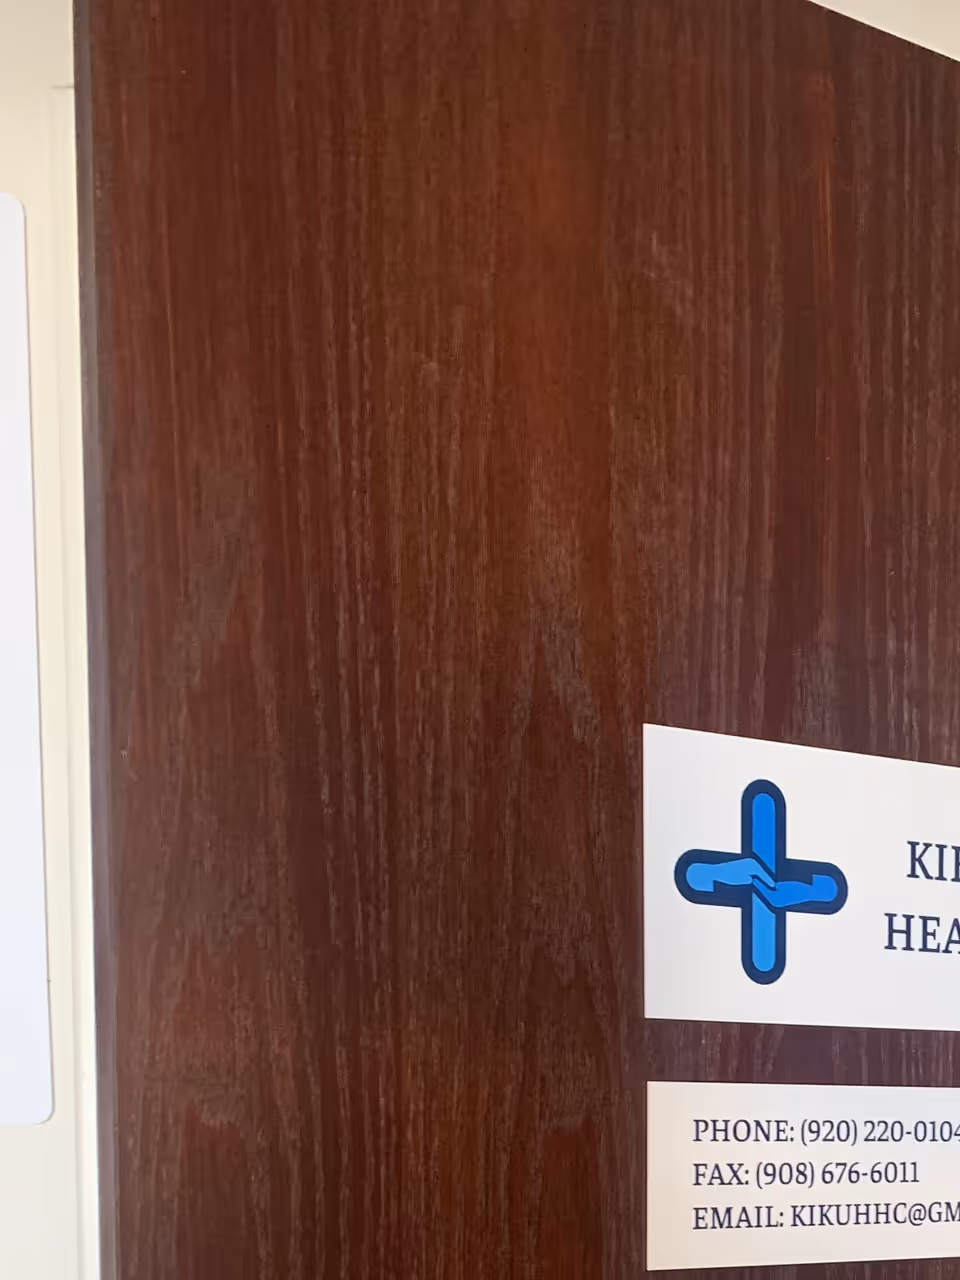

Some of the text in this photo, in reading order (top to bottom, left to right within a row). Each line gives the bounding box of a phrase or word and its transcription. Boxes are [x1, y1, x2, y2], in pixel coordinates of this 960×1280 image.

[692, 1118, 795, 1143] PHONE:
[800, 1118, 858, 1147] (920)
[692, 1161, 920, 1190] FAX: (908) 676-6011
[692, 1205, 784, 1230] EMAIL:
